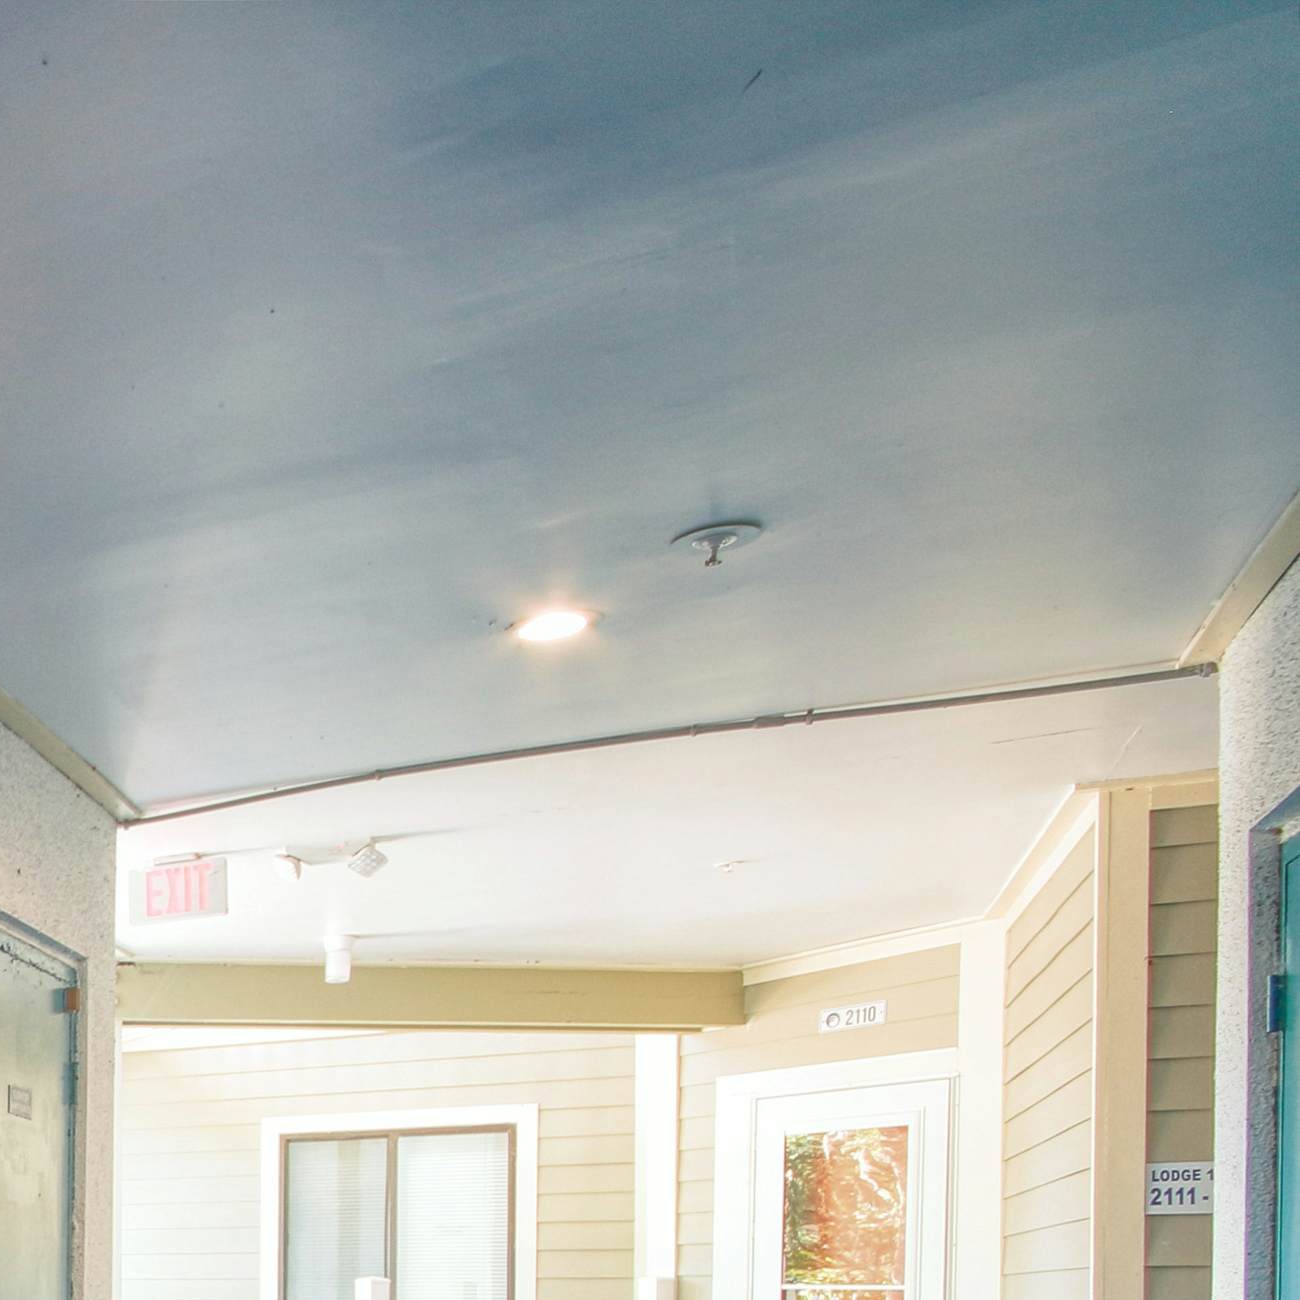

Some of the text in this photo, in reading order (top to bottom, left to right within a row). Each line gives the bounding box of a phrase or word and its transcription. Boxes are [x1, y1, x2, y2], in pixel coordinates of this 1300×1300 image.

[146, 863, 212, 917] EXIT
[845, 1005, 876, 1026] 2110
[1151, 1169, 1202, 1182] LODGE
[1149, 1187, 1196, 1206] 2111
